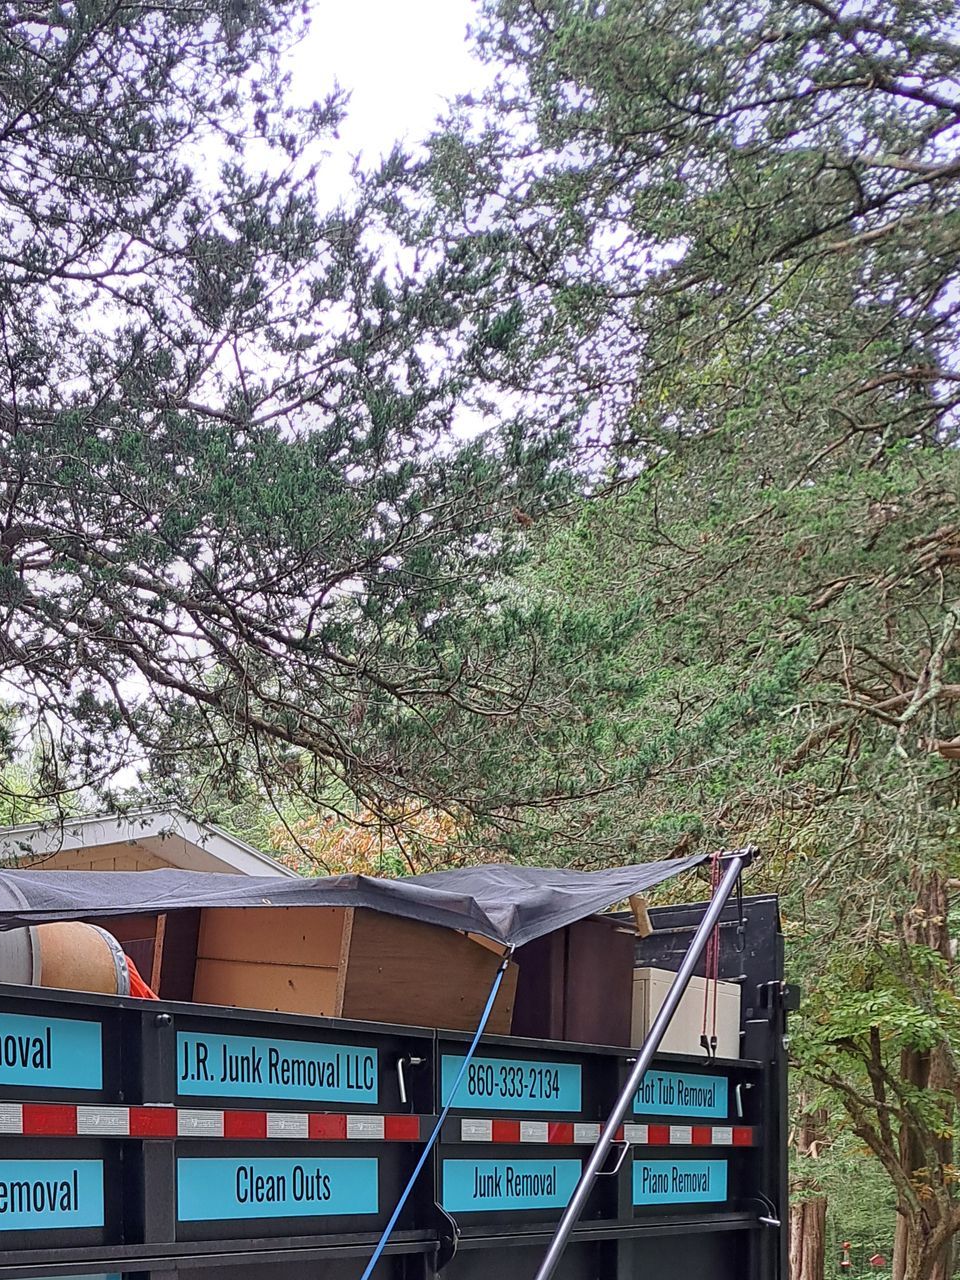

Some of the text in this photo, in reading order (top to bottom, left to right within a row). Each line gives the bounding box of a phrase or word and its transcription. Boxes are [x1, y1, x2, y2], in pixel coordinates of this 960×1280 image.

[181, 1041, 374, 1091] J.R. Junk Removal LLC
[467, 1063, 560, 1099] 860-333-2134
[637, 1078, 715, 1107] Hot Tub Removal
[236, 1164, 330, 1203] Clean Outs
[473, 1166, 556, 1197] Junk Removal
[642, 1166, 710, 1194] Piano Removal
